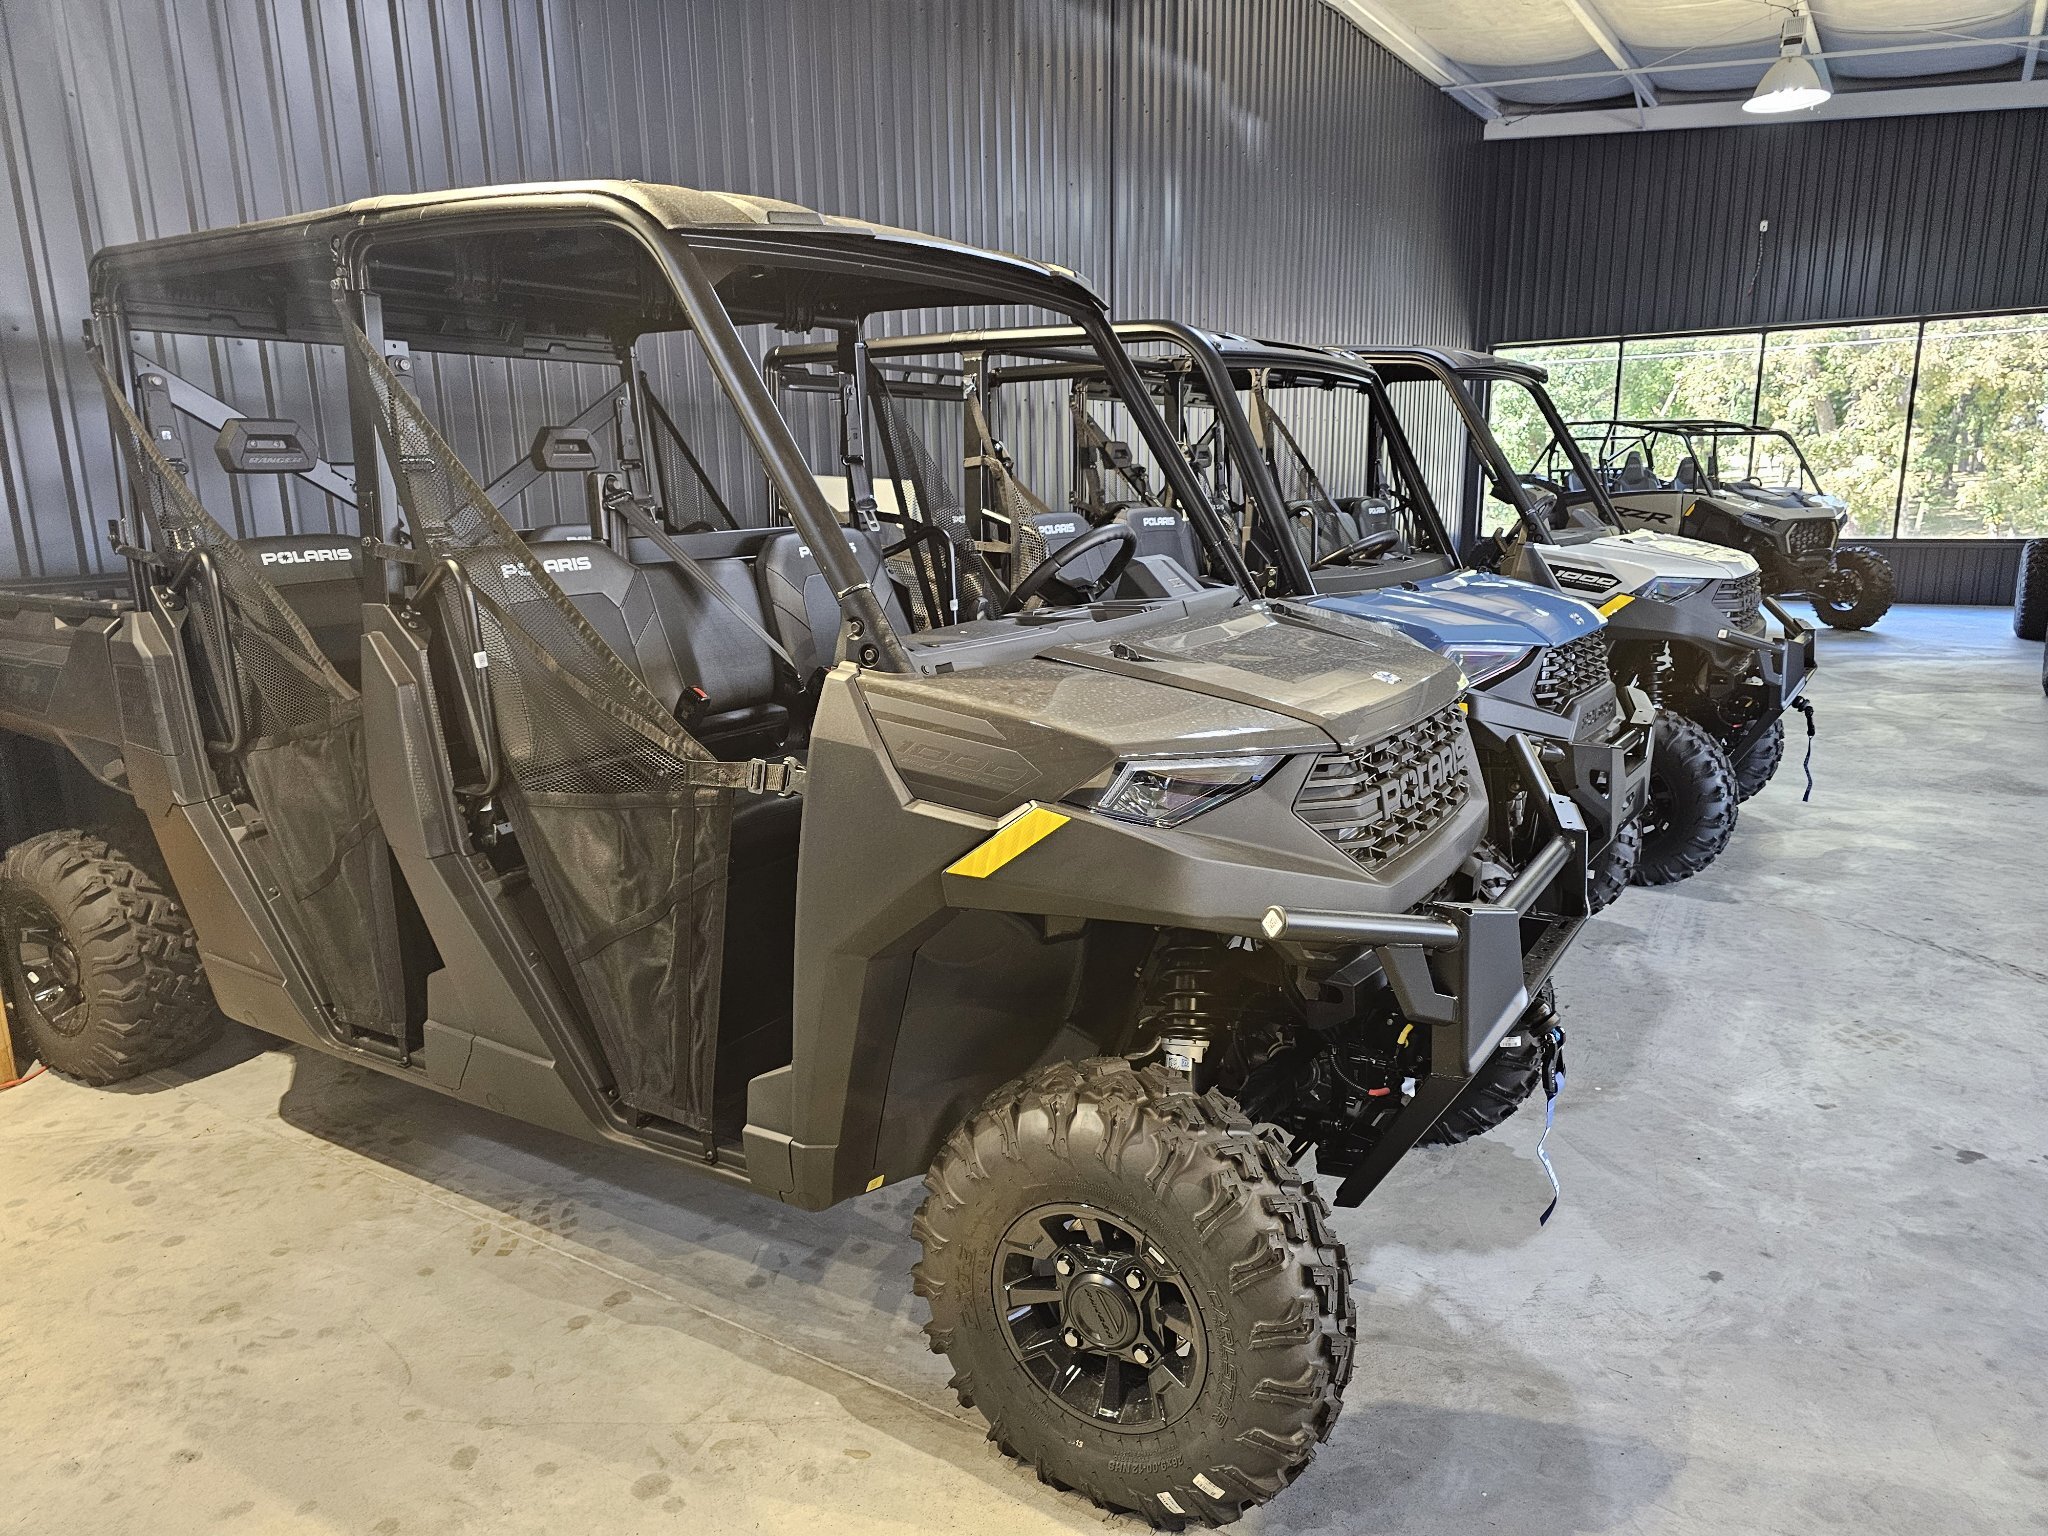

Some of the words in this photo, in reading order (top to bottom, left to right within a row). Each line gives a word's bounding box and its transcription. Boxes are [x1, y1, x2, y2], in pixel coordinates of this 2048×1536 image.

[1038, 522, 1075, 535] POLARIS
[1143, 516, 1175, 526] POLARIS
[261, 548, 352, 565] POLARIS
[1556, 570, 1617, 586] 1000
[896, 741, 1030, 781] 1000
[1207, 1290, 1237, 1428] CARLSTAR
